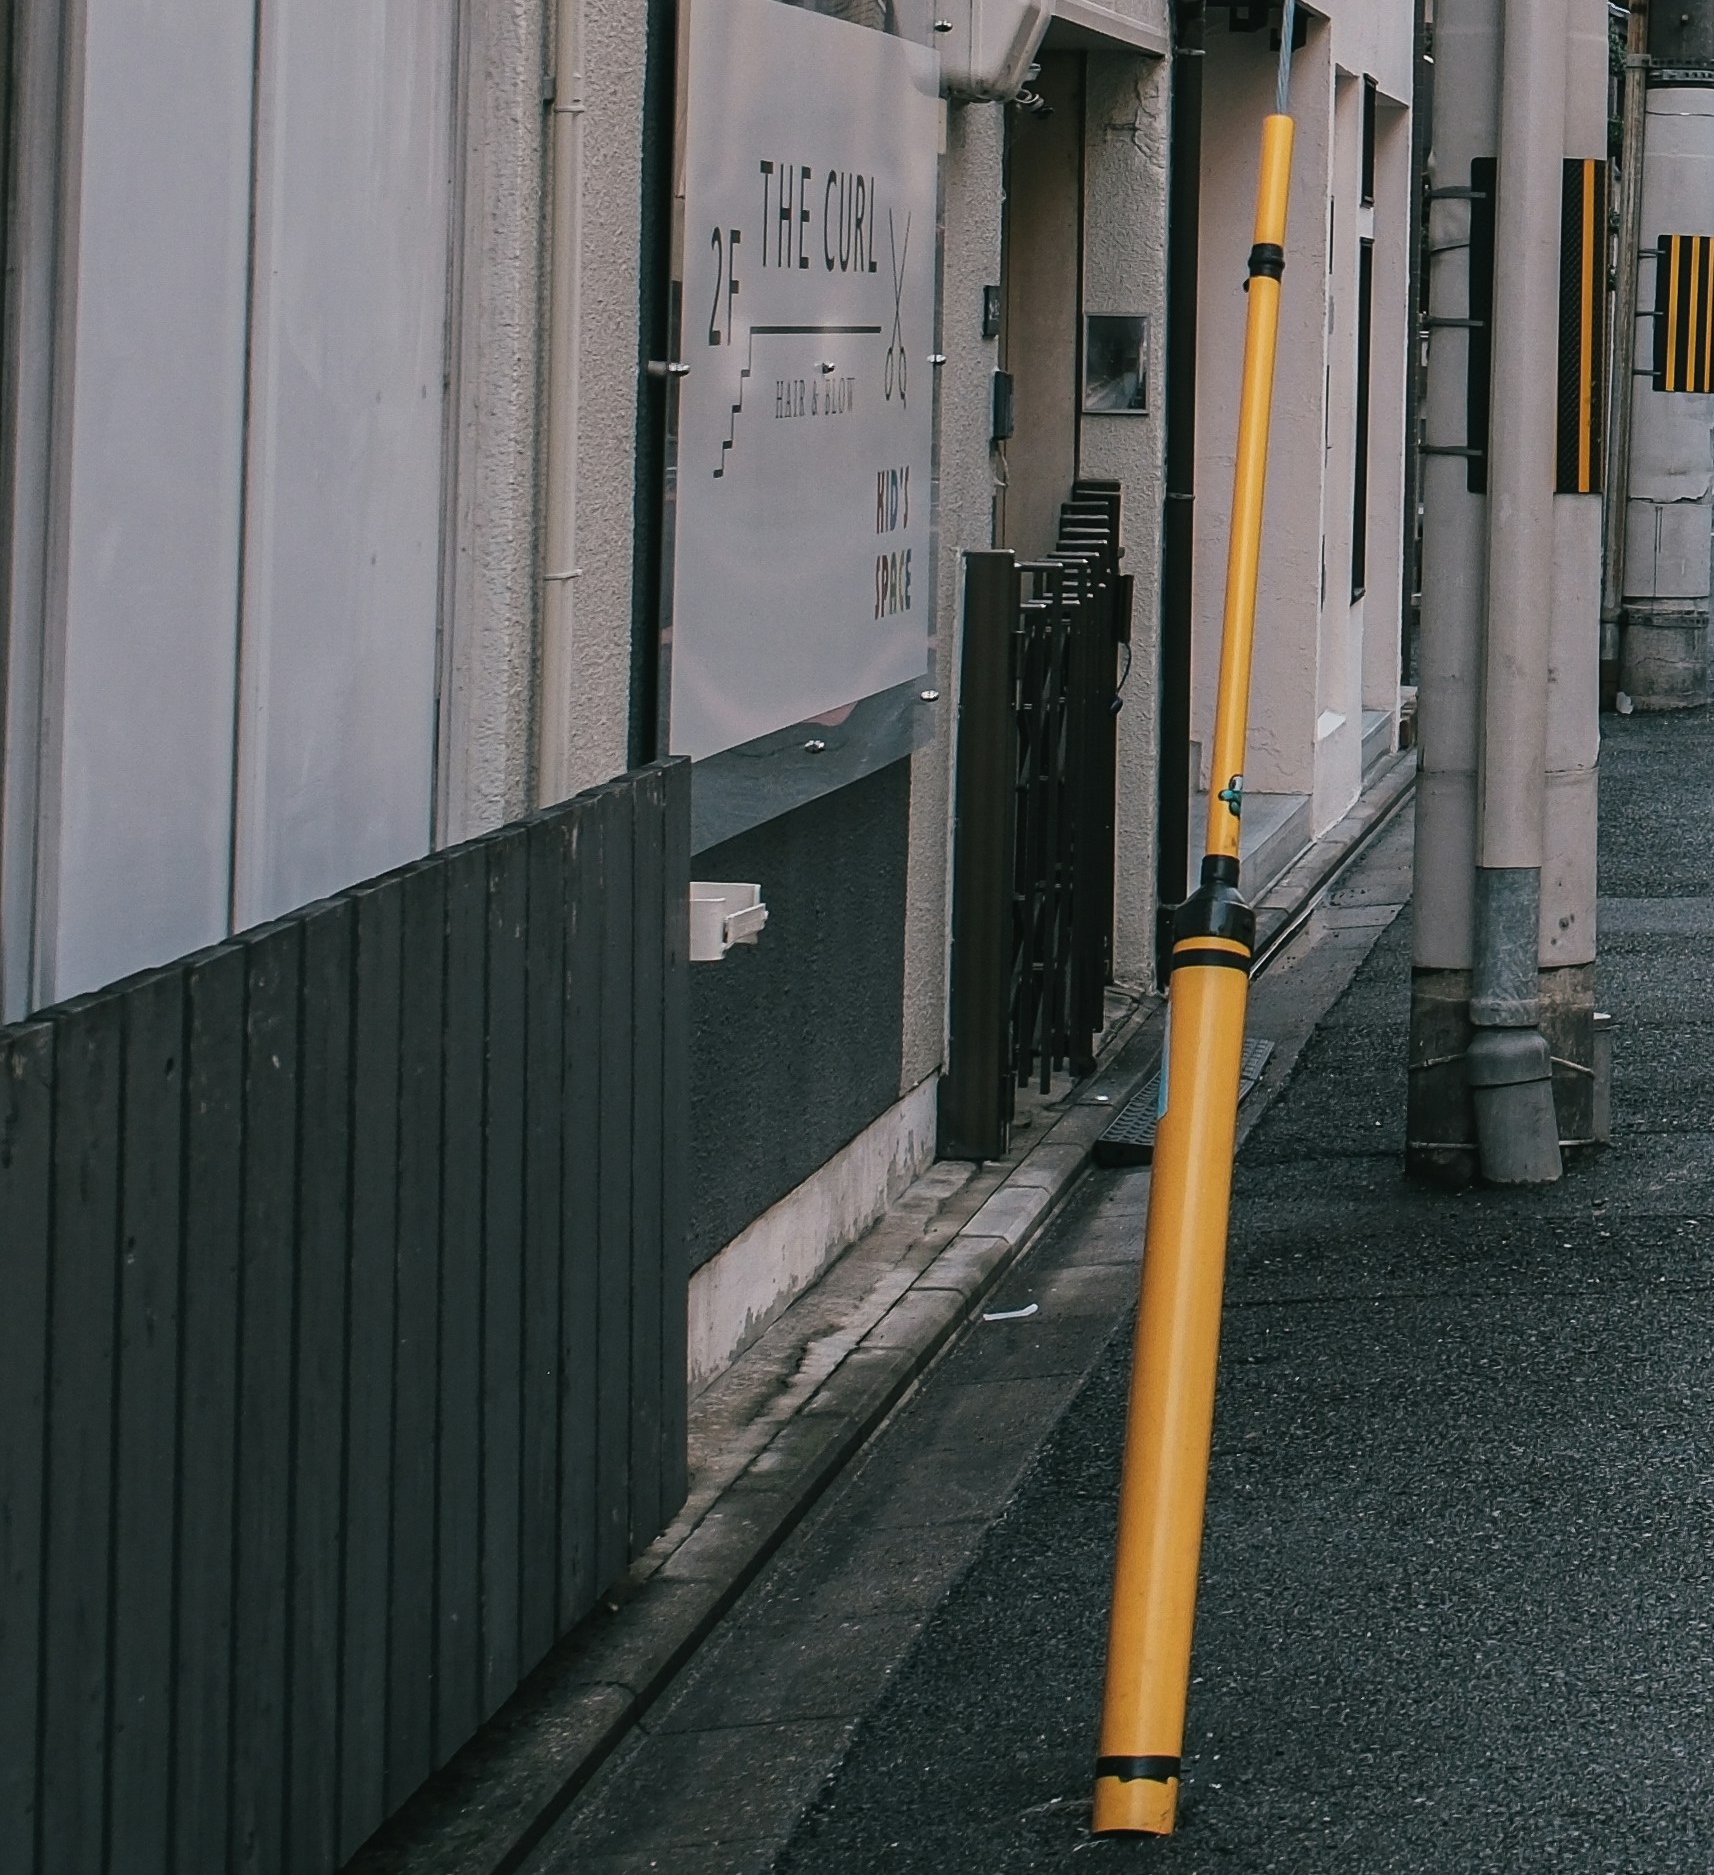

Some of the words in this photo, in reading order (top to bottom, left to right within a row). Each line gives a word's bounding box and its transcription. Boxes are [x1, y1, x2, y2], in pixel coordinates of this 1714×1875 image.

[760, 159, 811, 270] THE
[823, 169, 878, 273] CURL
[708, 226, 741, 346] 2F
[776, 379, 806, 419] HAIR
[875, 465, 910, 535] KID'S
[875, 548, 912, 621] SPACE
